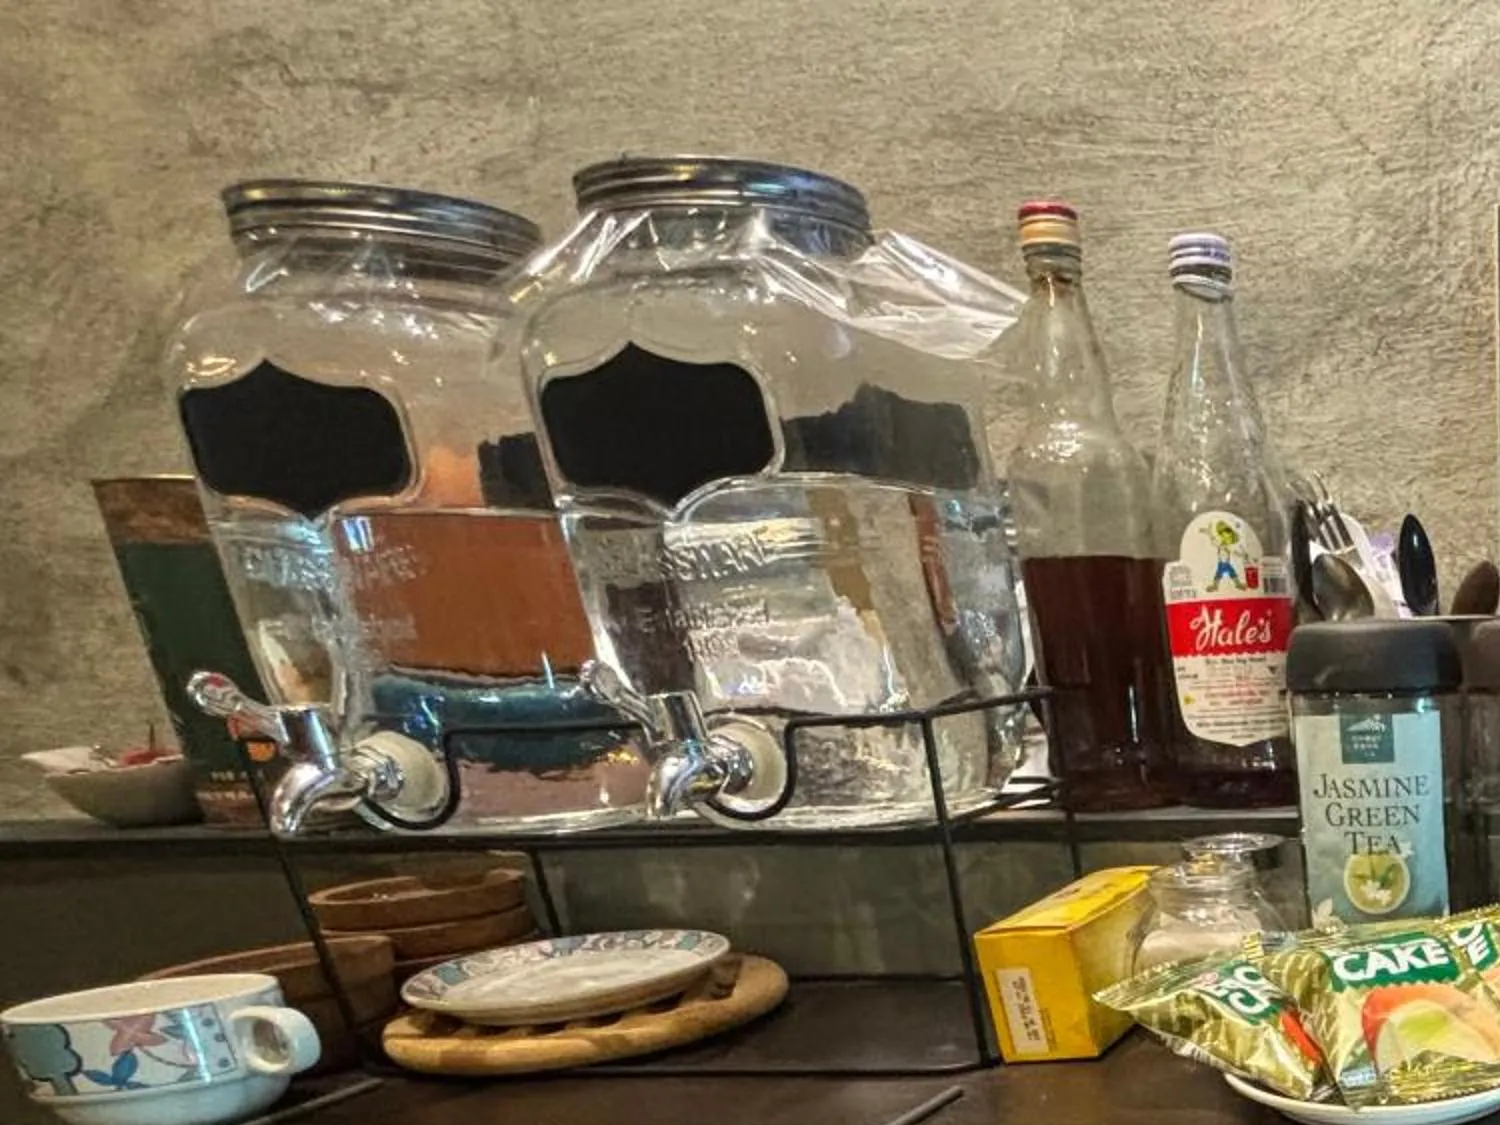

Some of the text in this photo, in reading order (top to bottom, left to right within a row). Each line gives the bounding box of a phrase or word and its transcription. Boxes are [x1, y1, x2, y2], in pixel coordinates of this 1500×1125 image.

[1189, 604, 1273, 650] Hale's
[1313, 773, 1430, 799] JASMINE
[1325, 802, 1421, 828] GREEN
[1344, 831, 1403, 855] TEA
[1333, 937, 1450, 981] CAKE
